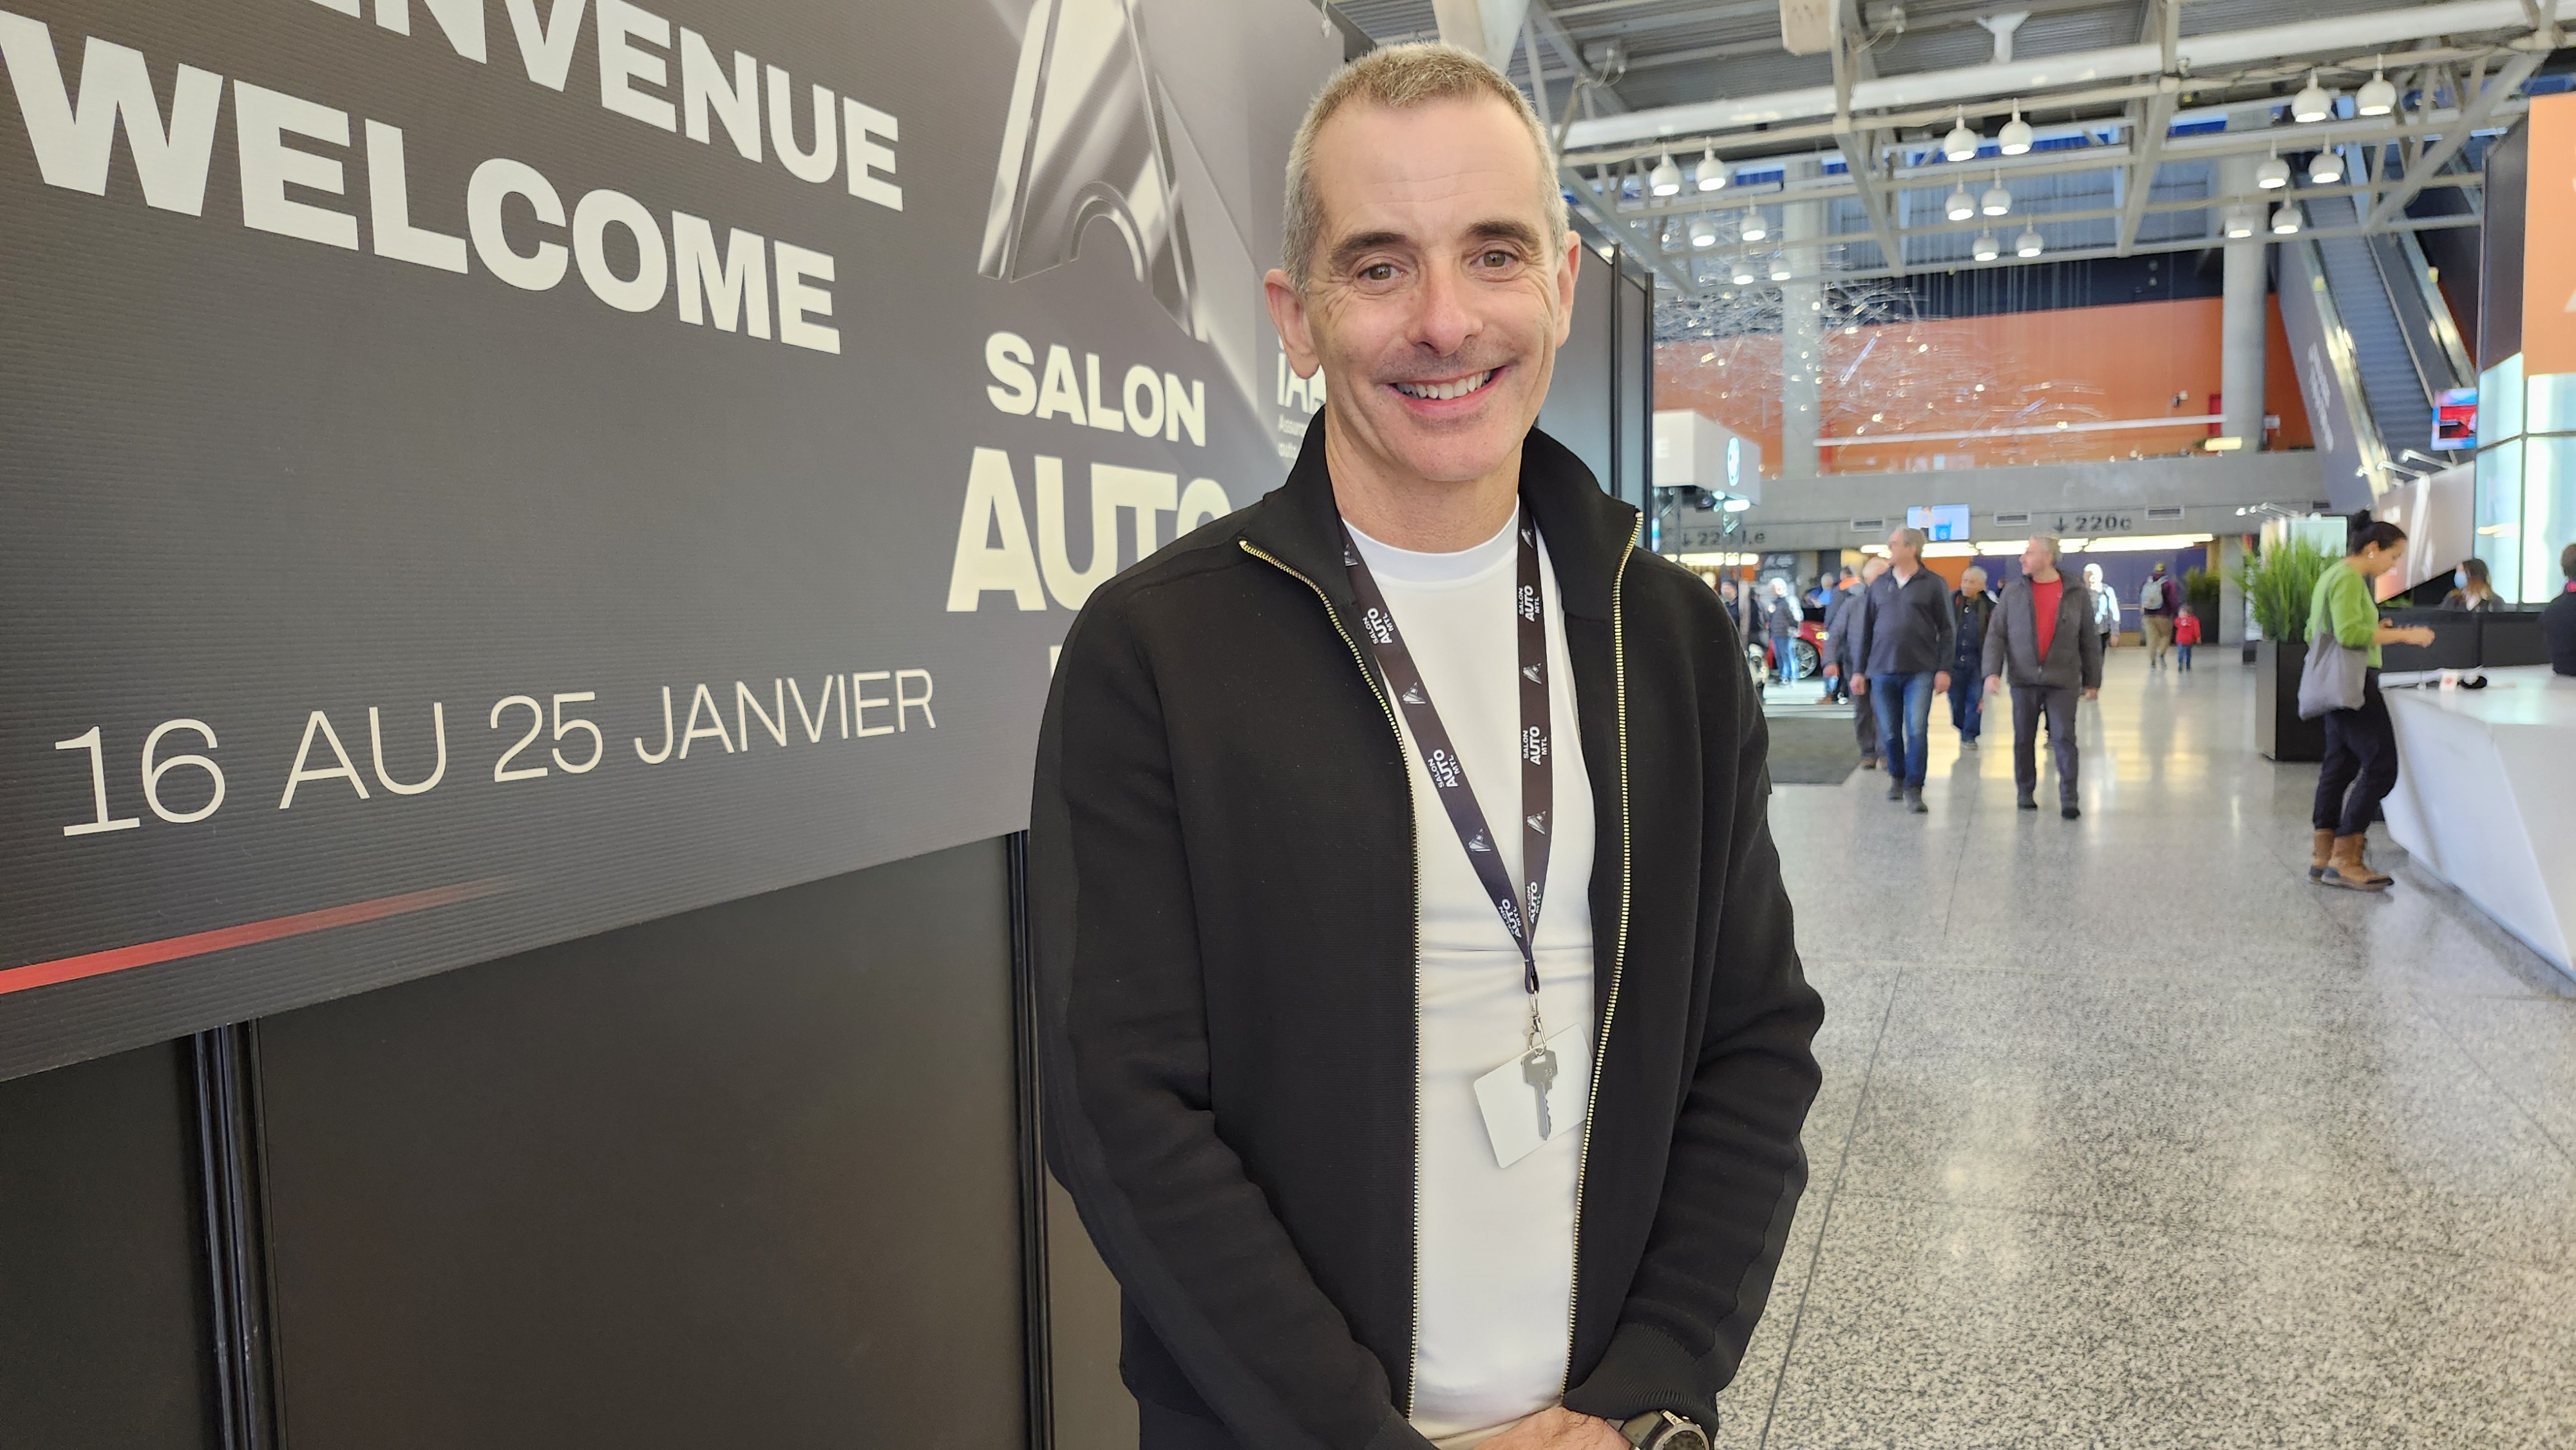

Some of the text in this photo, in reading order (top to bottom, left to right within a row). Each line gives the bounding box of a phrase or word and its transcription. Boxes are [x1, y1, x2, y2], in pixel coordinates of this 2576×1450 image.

[310, 0, 904, 211] VENUE
[0, 10, 840, 355] WELCOME
[985, 332, 1206, 447] SALON
[2075, 514, 2132, 532] 220c
[1383, 612, 1394, 632] MTL
[1524, 585, 1535, 622] AUTO
[1362, 617, 1379, 645] SALON
[1367, 608, 1392, 644] AUTO
[55, 668, 936, 836] 16 AU 25 JANVIER
[1529, 726, 1541, 766] AUTO
[1428, 758, 1444, 788] SALON
[1434, 749, 1459, 787] AUTO
[1449, 755, 1461, 775] MTL
[1501, 898, 1522, 938] AUTO
[1512, 905, 1522, 927] MTL
